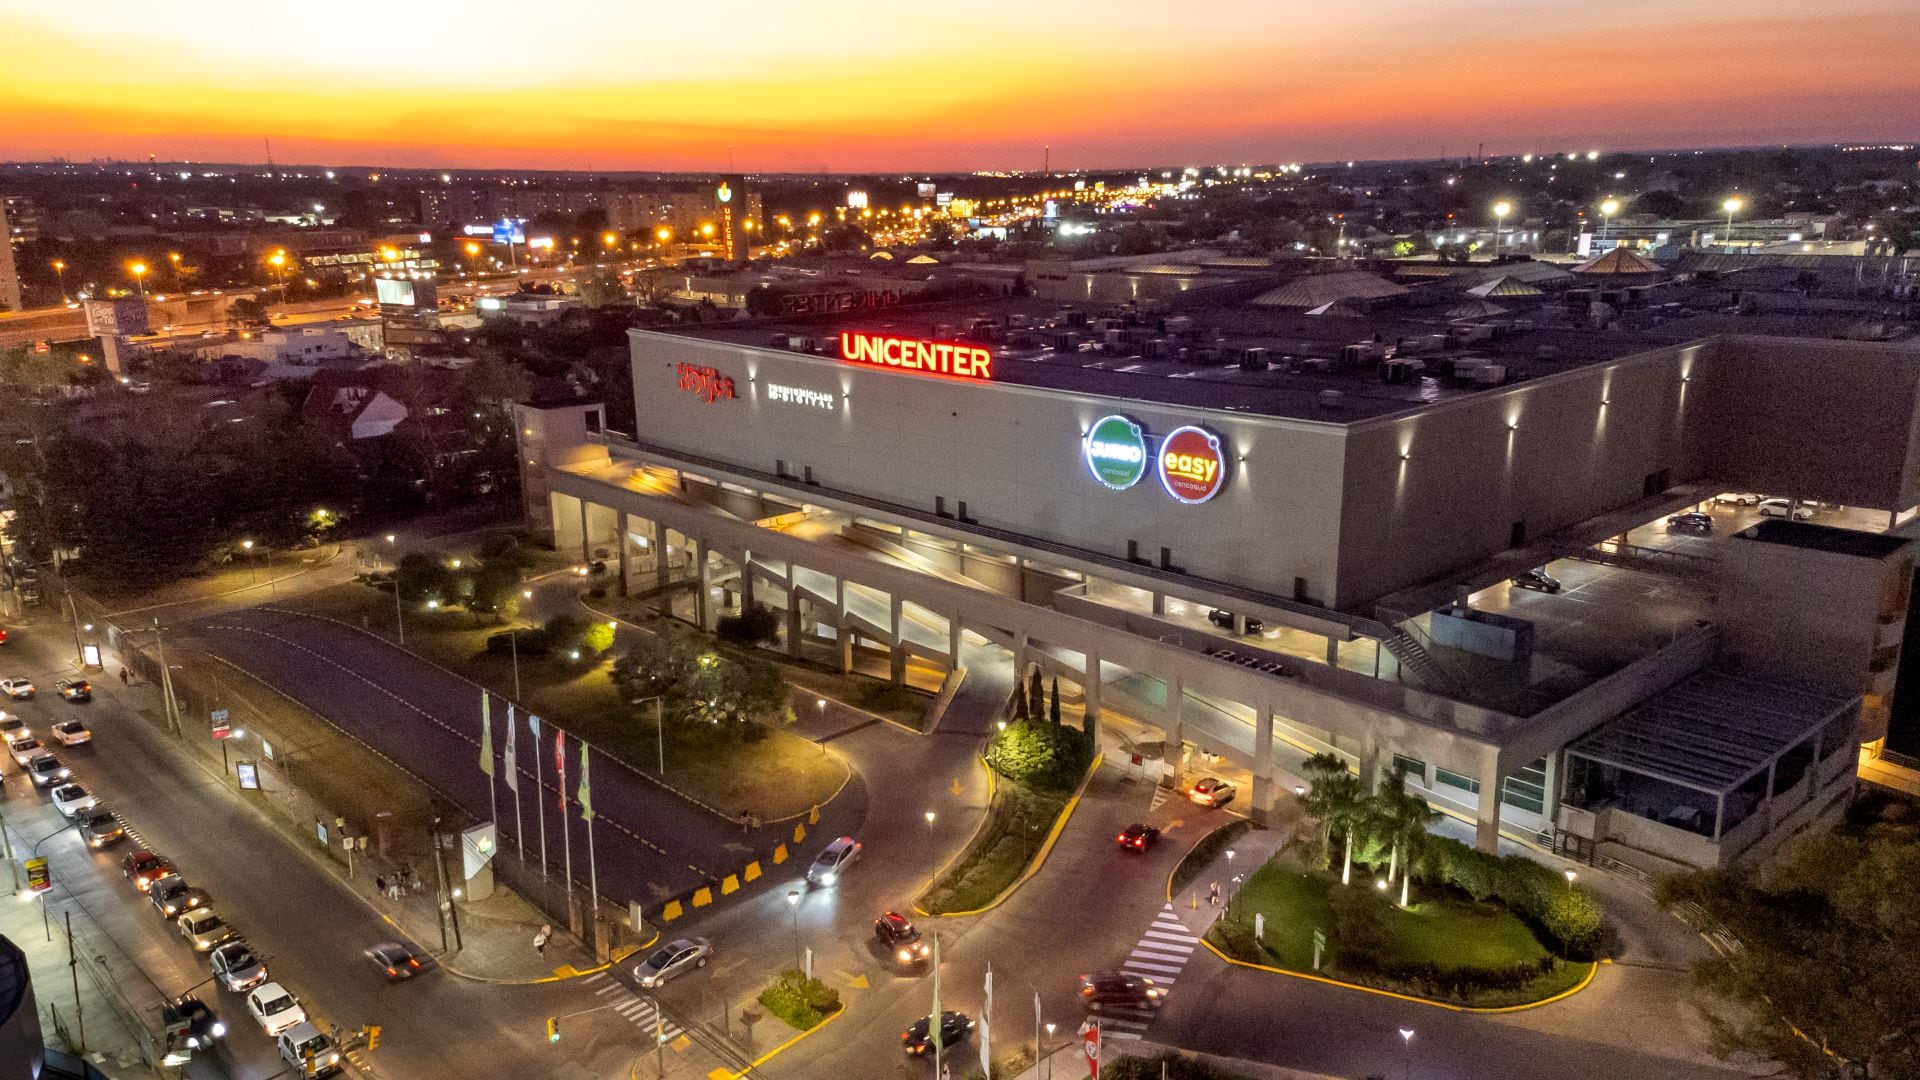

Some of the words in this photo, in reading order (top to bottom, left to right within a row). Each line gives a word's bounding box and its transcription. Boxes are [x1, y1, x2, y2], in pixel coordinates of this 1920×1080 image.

[723, 207, 734, 260] UNICENTE
[842, 333, 991, 378] UNICENTER
[1165, 452, 1218, 482] easy
[1174, 481, 1207, 491] cencosud
